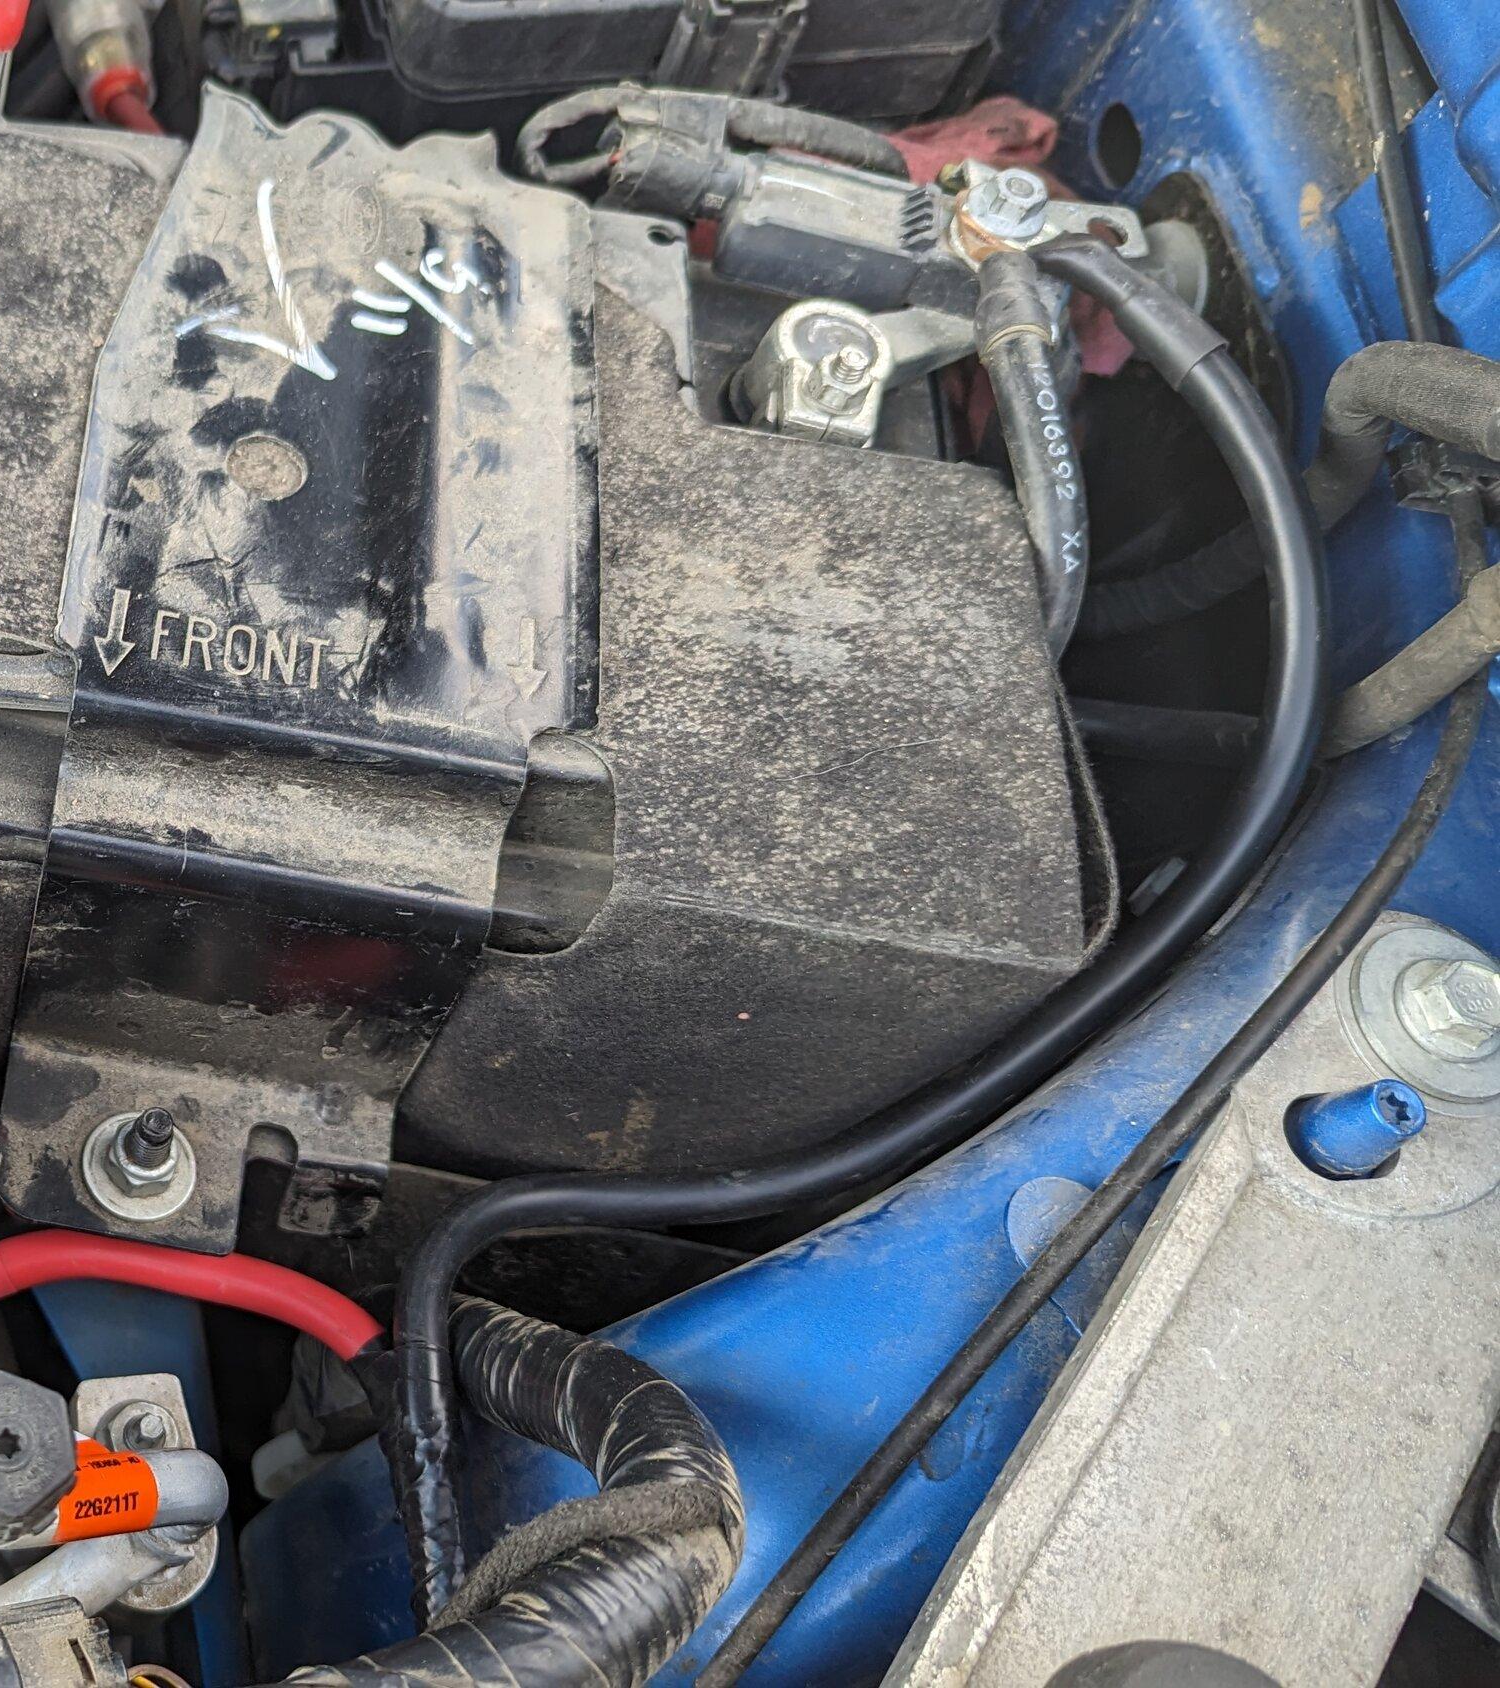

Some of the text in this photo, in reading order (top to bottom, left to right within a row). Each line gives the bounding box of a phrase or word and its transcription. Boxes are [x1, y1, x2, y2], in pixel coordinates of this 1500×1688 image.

[1027, 362, 1081, 575] 12016392 XA
[149, 608, 331, 690] FRONT
[74, 1491, 140, 1520] 22G211T
